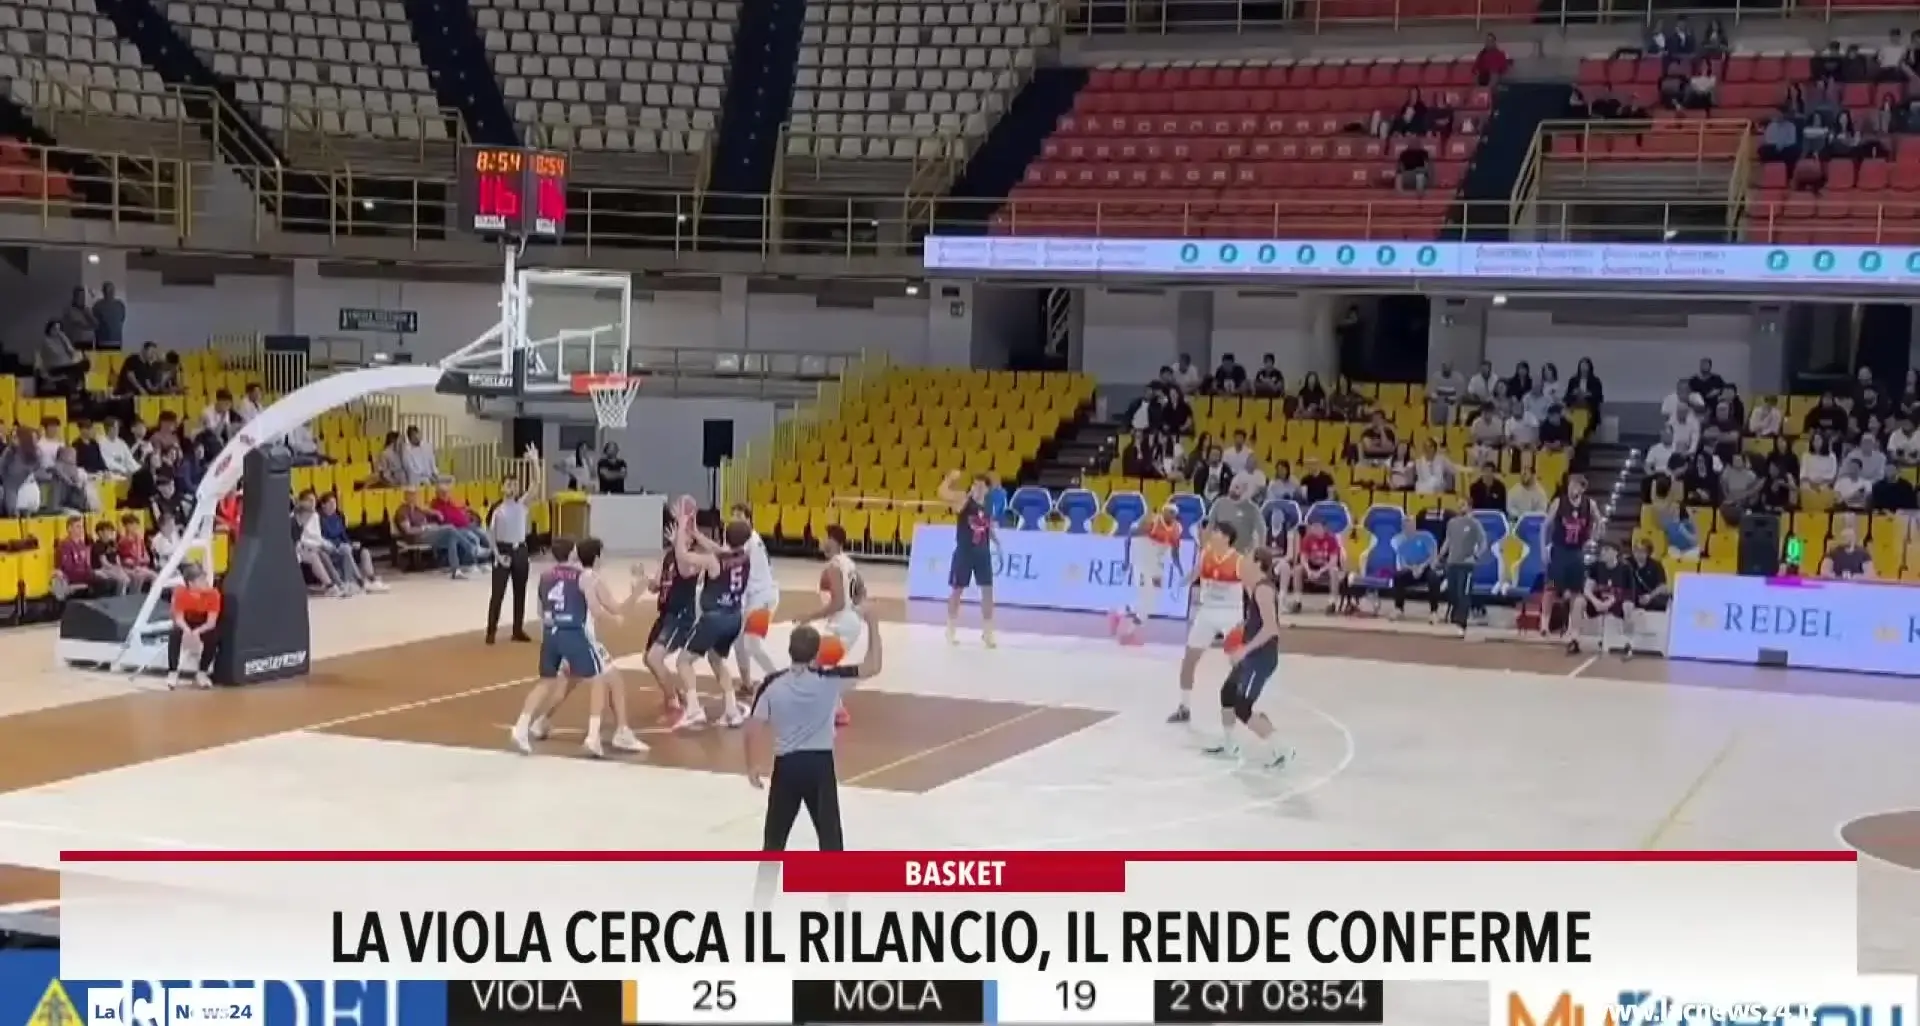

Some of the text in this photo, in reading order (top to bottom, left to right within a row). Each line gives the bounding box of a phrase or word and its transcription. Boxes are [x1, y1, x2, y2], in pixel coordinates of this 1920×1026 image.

[477, 151, 520, 172] 8:54
[730, 565, 743, 592] 5
[547, 580, 565, 611] 4
